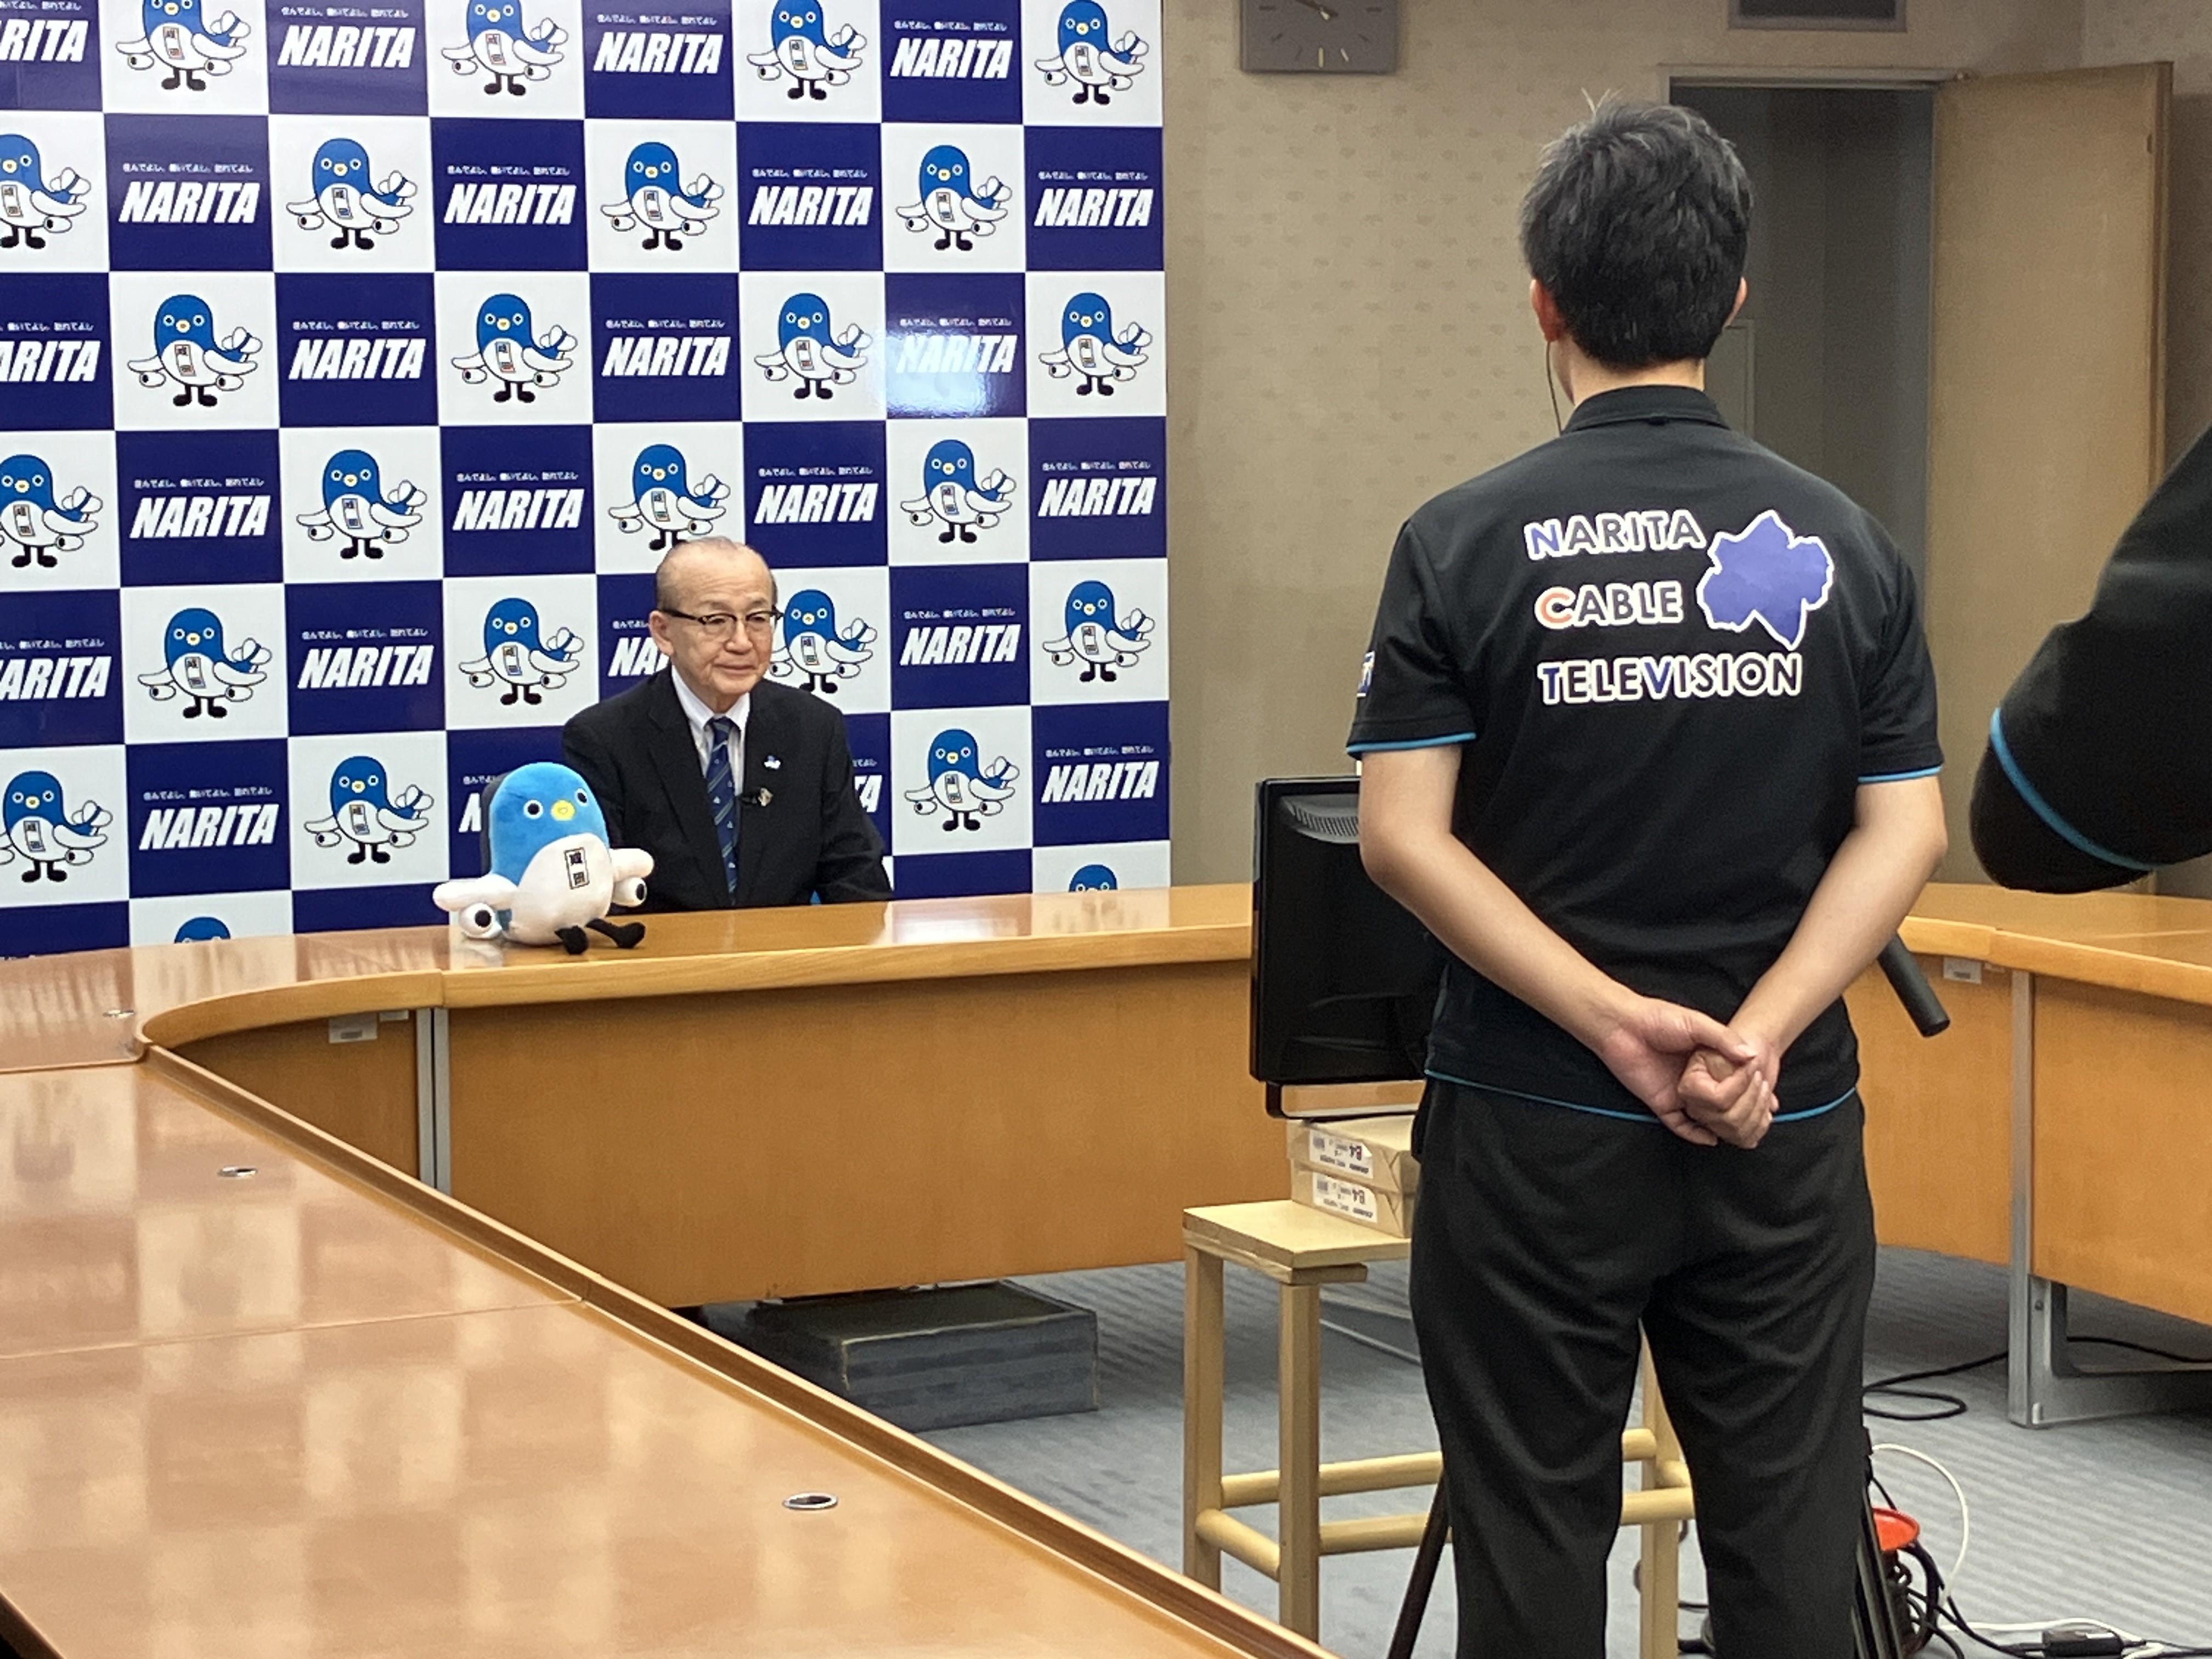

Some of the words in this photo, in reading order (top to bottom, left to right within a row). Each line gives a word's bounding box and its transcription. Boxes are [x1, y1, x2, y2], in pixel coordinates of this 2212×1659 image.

[0, 19, 88, 61] RITA
[278, 25, 415, 67] NARITA
[594, 32, 723, 73] NARITA
[890, 38, 1013, 78] NARITA
[119, 182, 259, 223] NARITA
[444, 184, 576, 224] NARITA
[748, 187, 873, 225] NARITA
[1035, 189, 1153, 226] NARITA
[289, 339, 425, 379] NARITA
[602, 337, 730, 376] NARITA
[896, 335, 1017, 373] NARITA
[130, 495, 270, 538] NARITA
[453, 489, 584, 530] NARITA
[754, 483, 878, 523] NARITA
[1039, 478, 1156, 516] NARITA
[1524, 510, 1706, 560] NARITA
[1535, 580, 1683, 629] CABLE
[900, 624, 1020, 665] NARITA
[0, 657, 111, 699] ARITA
[298, 645, 434, 689] NARITA
[1538, 653, 1802, 704] TELEVISION
[1042, 761, 1159, 803] NARITA
[139, 804, 279, 850] NARITA
